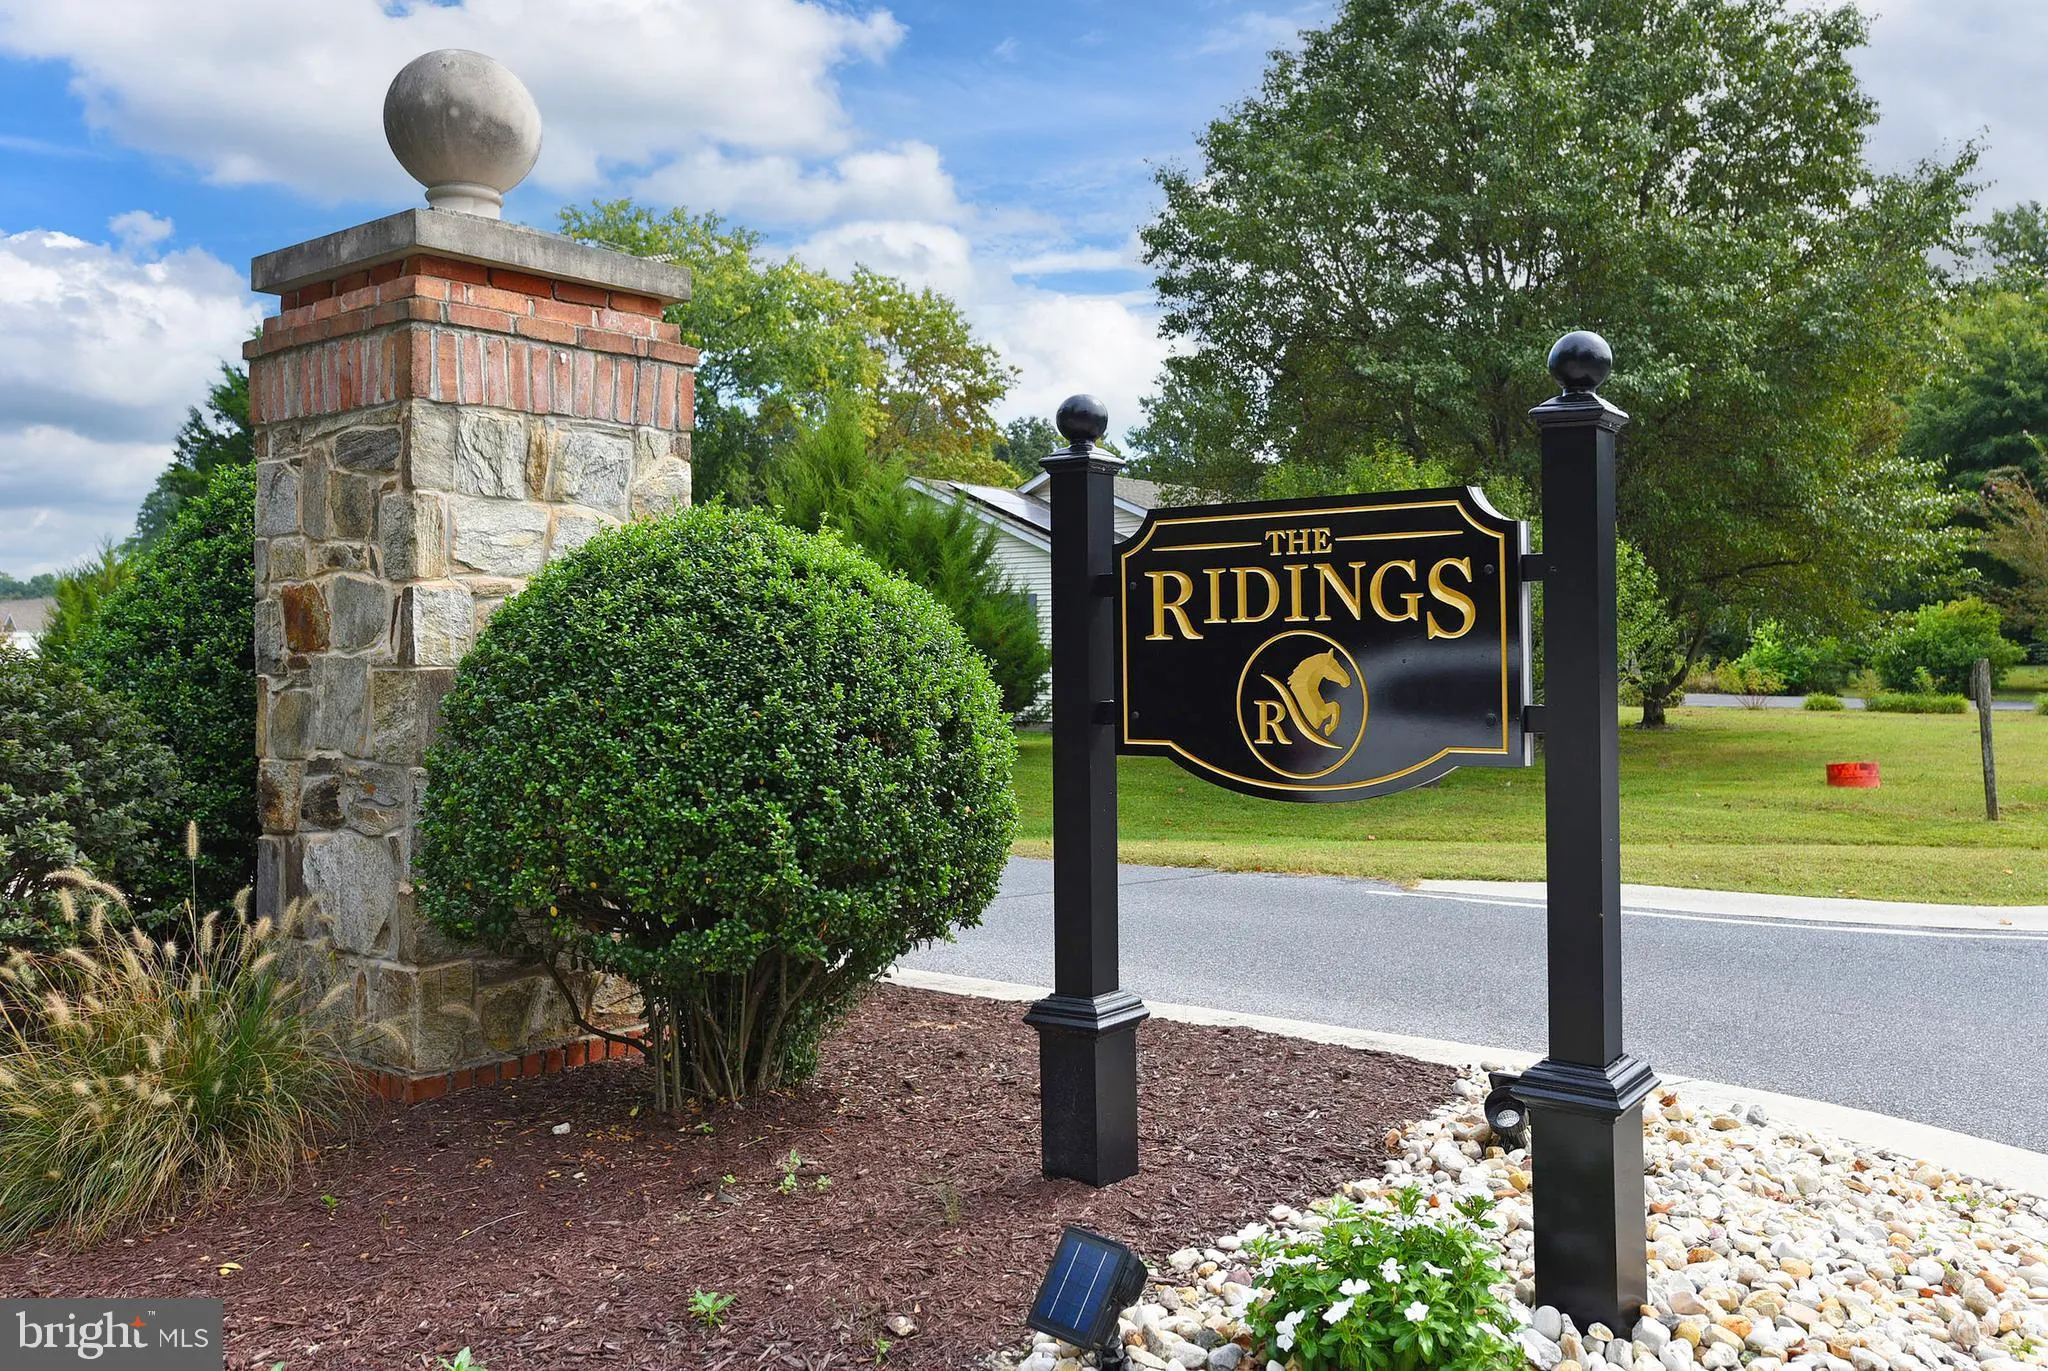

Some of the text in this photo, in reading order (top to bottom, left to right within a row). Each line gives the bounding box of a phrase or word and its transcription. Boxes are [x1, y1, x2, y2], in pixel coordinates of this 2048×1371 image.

[1264, 527, 1333, 556] THE
[1144, 556, 1477, 641] RIDINGS
[1253, 700, 1293, 745] R
